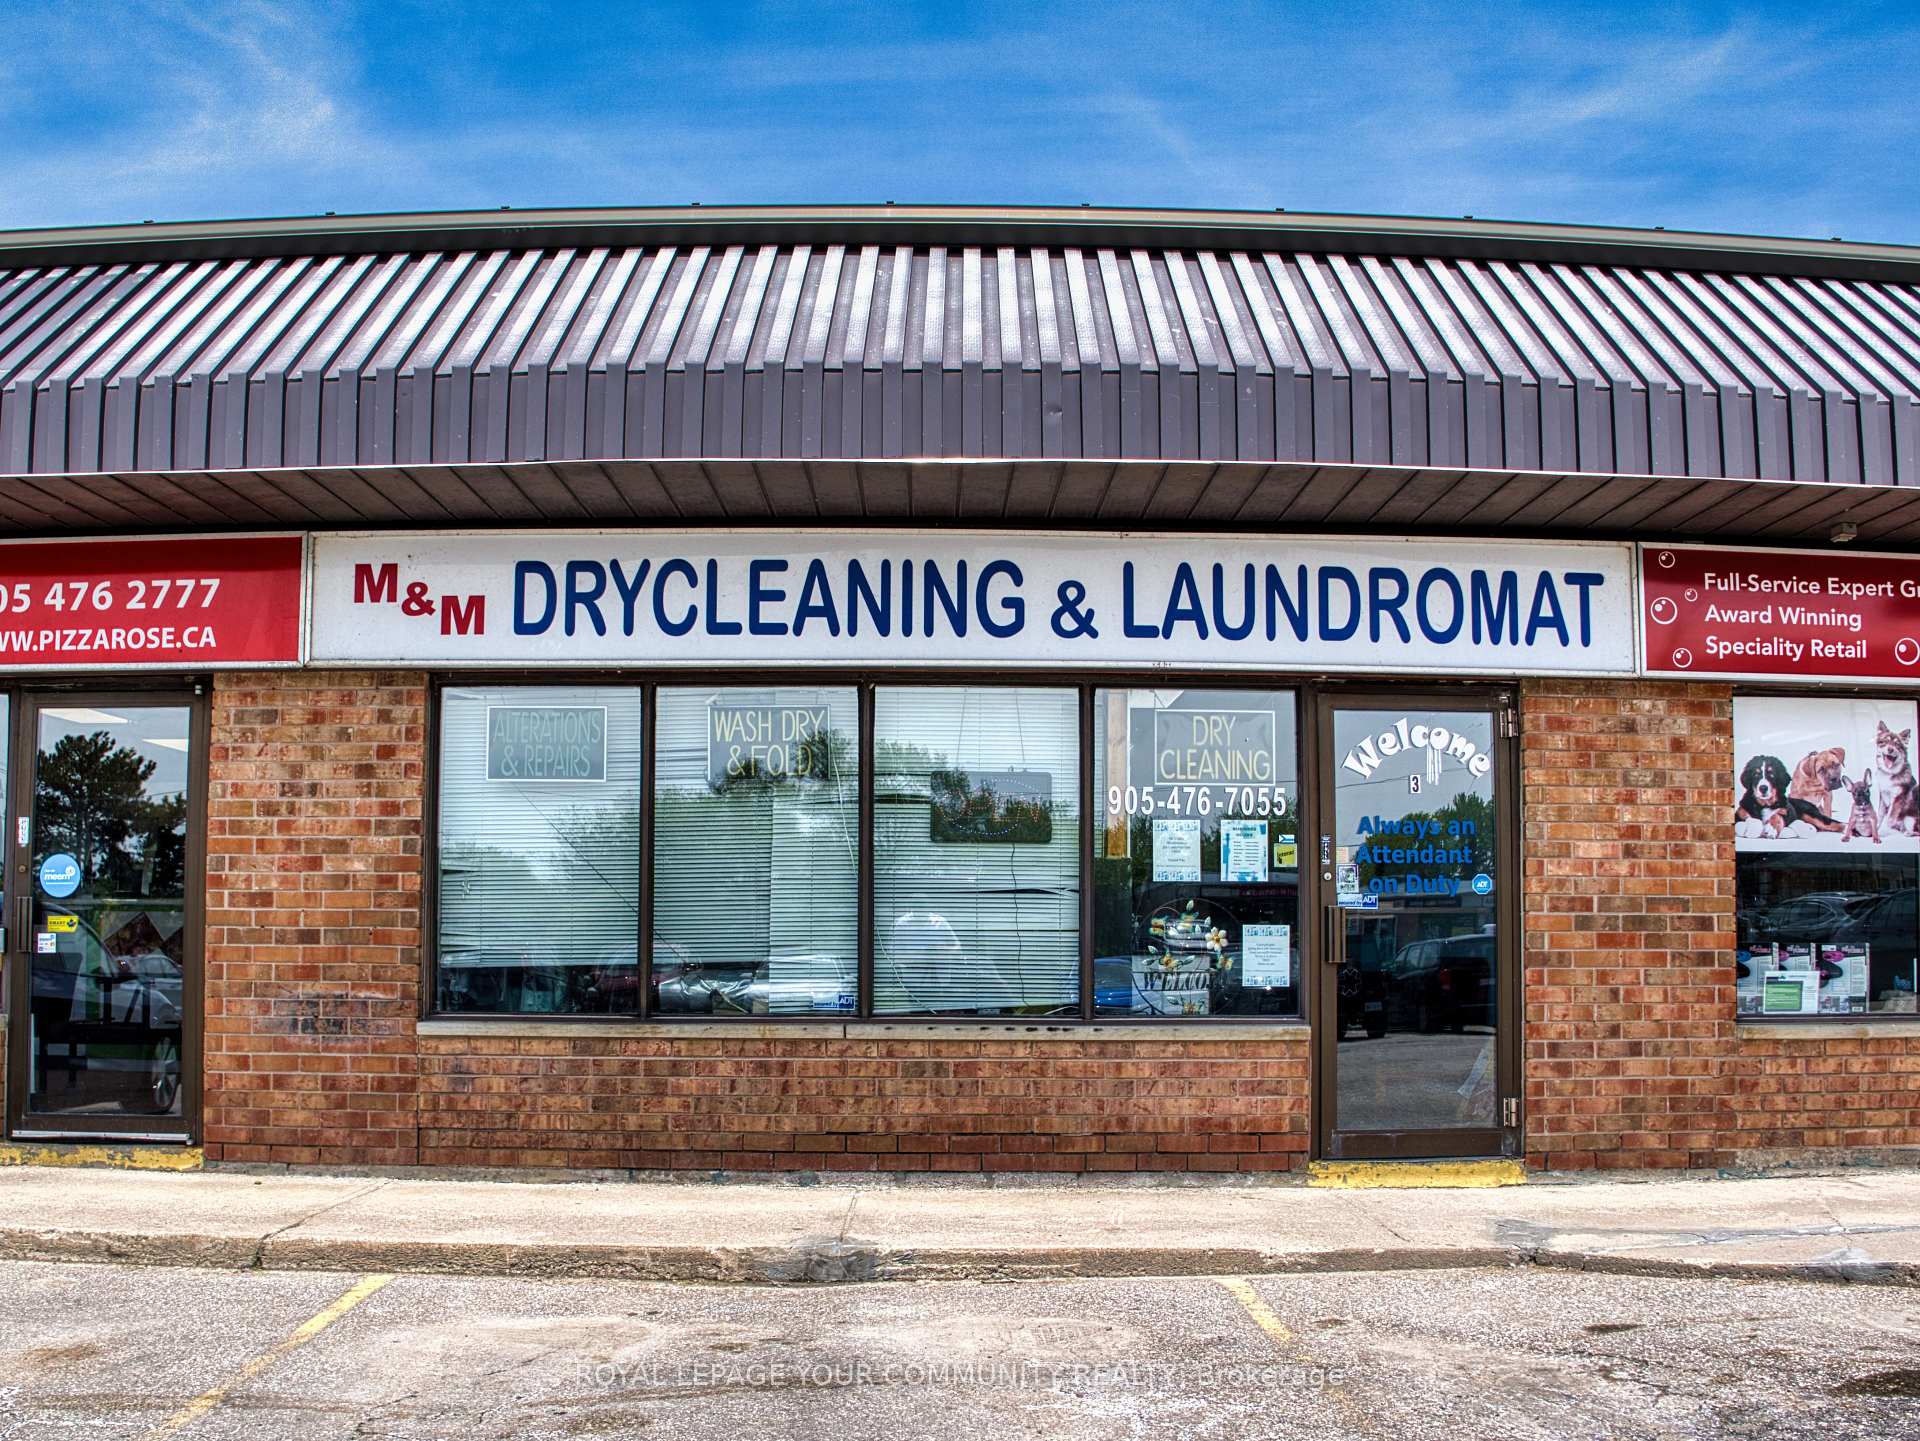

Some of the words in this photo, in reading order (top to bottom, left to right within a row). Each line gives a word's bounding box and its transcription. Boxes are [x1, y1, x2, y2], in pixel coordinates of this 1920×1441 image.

[44, 580, 113, 612] 476
[126, 578, 220, 610] 2777
[1704, 572, 1820, 594] Full-Service
[1827, 577, 1894, 600] Expert
[513, 558, 1025, 638] DRYCLEANING
[1050, 580, 1099, 640] &
[1122, 561, 1605, 648] LAUNDROMAT
[1704, 604, 1772, 624] Award
[1778, 606, 1862, 631] Winning
[1705, 635, 1804, 661] Speciality
[1811, 638, 1867, 658] Retail
[494, 710, 601, 742] ALTERATIONS
[714, 710, 773, 742] WASH
[782, 710, 826, 742] DRY
[1192, 715, 1237, 747] DRY
[501, 747, 519, 776] &
[527, 746, 592, 777] REPAIRS
[727, 745, 746, 776] &
[751, 745, 812, 777] FOLD
[1341, 717, 1490, 780] Welcome
[1160, 748, 1271, 780] CLEANING
[1411, 775, 1420, 793] 3
[1108, 786, 1287, 816] 905-476-7055
[1356, 815, 1444, 839] Always
[1447, 819, 1475, 835] an
[1355, 844, 1473, 865] Attendant
[1368, 876, 1398, 894] on
[1405, 873, 1461, 898] Duty
[1476, 880, 1489, 889] ADT
[1362, 895, 1377, 904] ADT
[840, 996, 854, 1004] ADT
